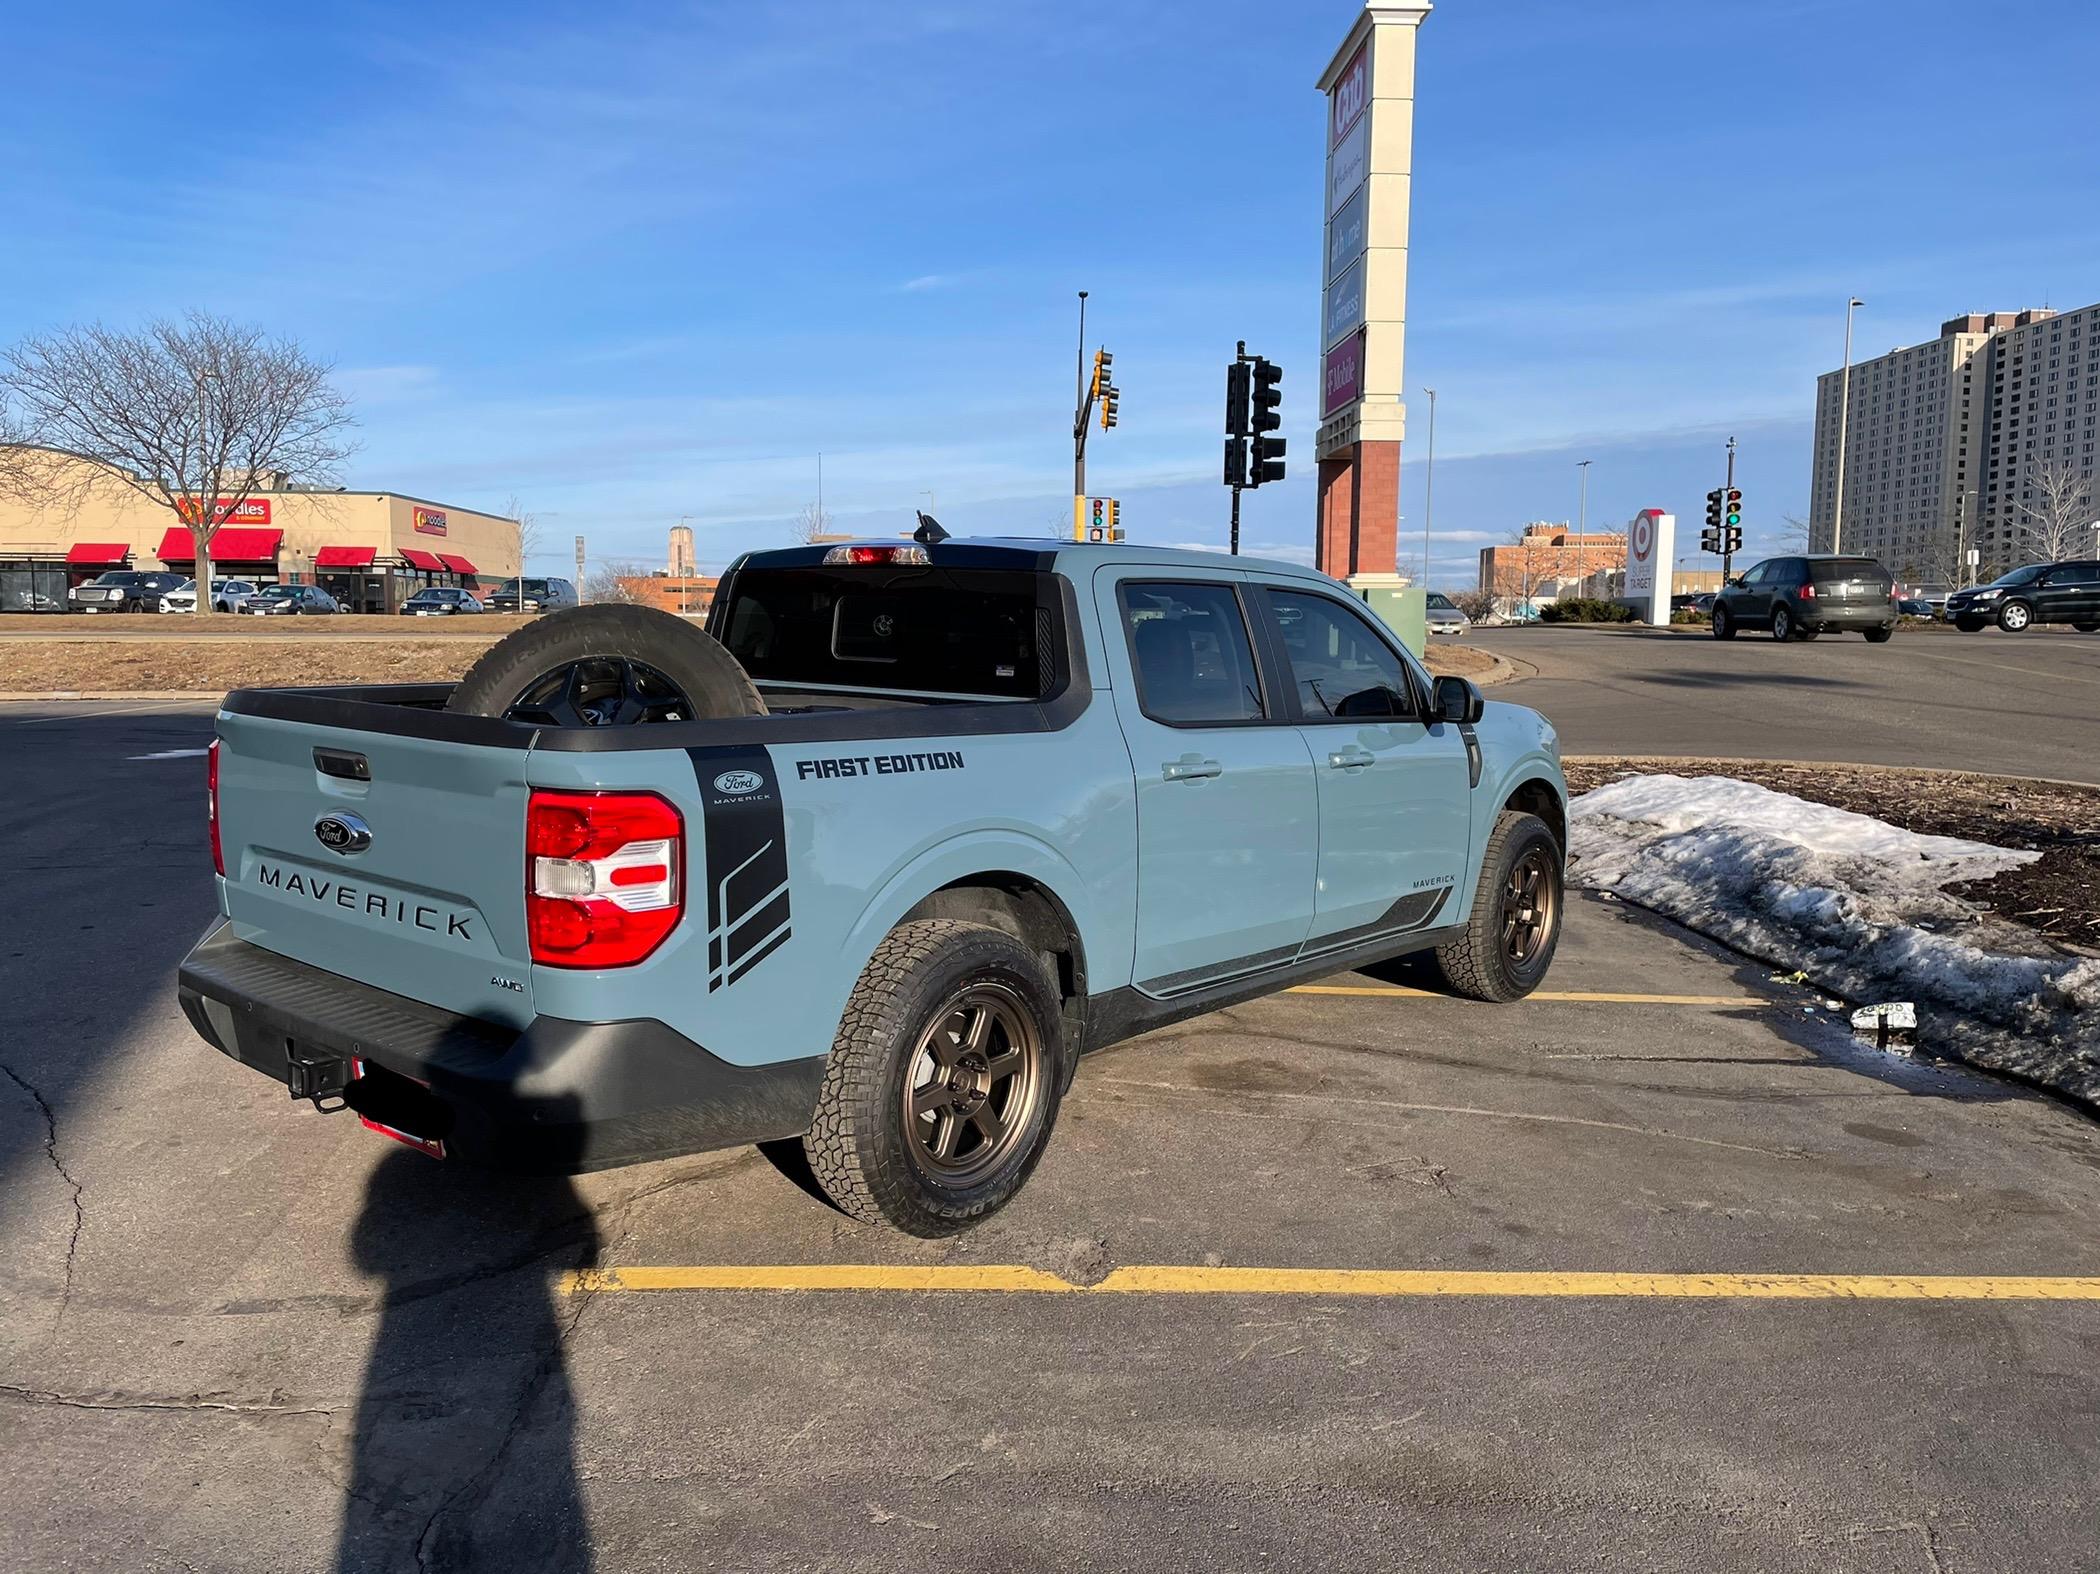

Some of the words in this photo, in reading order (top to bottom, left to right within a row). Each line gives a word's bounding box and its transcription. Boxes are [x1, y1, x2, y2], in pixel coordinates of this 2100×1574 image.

[1630, 577, 1652, 590] TARGET
[796, 757, 870, 780] FIRST
[874, 751, 965, 775] EDITION
[724, 774, 754, 790] Ford
[713, 794, 771, 805] MAVERICK
[320, 821, 343, 843] Ford
[1412, 875, 1455, 888] MAVERICK
[258, 864, 474, 941] MAVERICK
[490, 976, 524, 993] AWD
